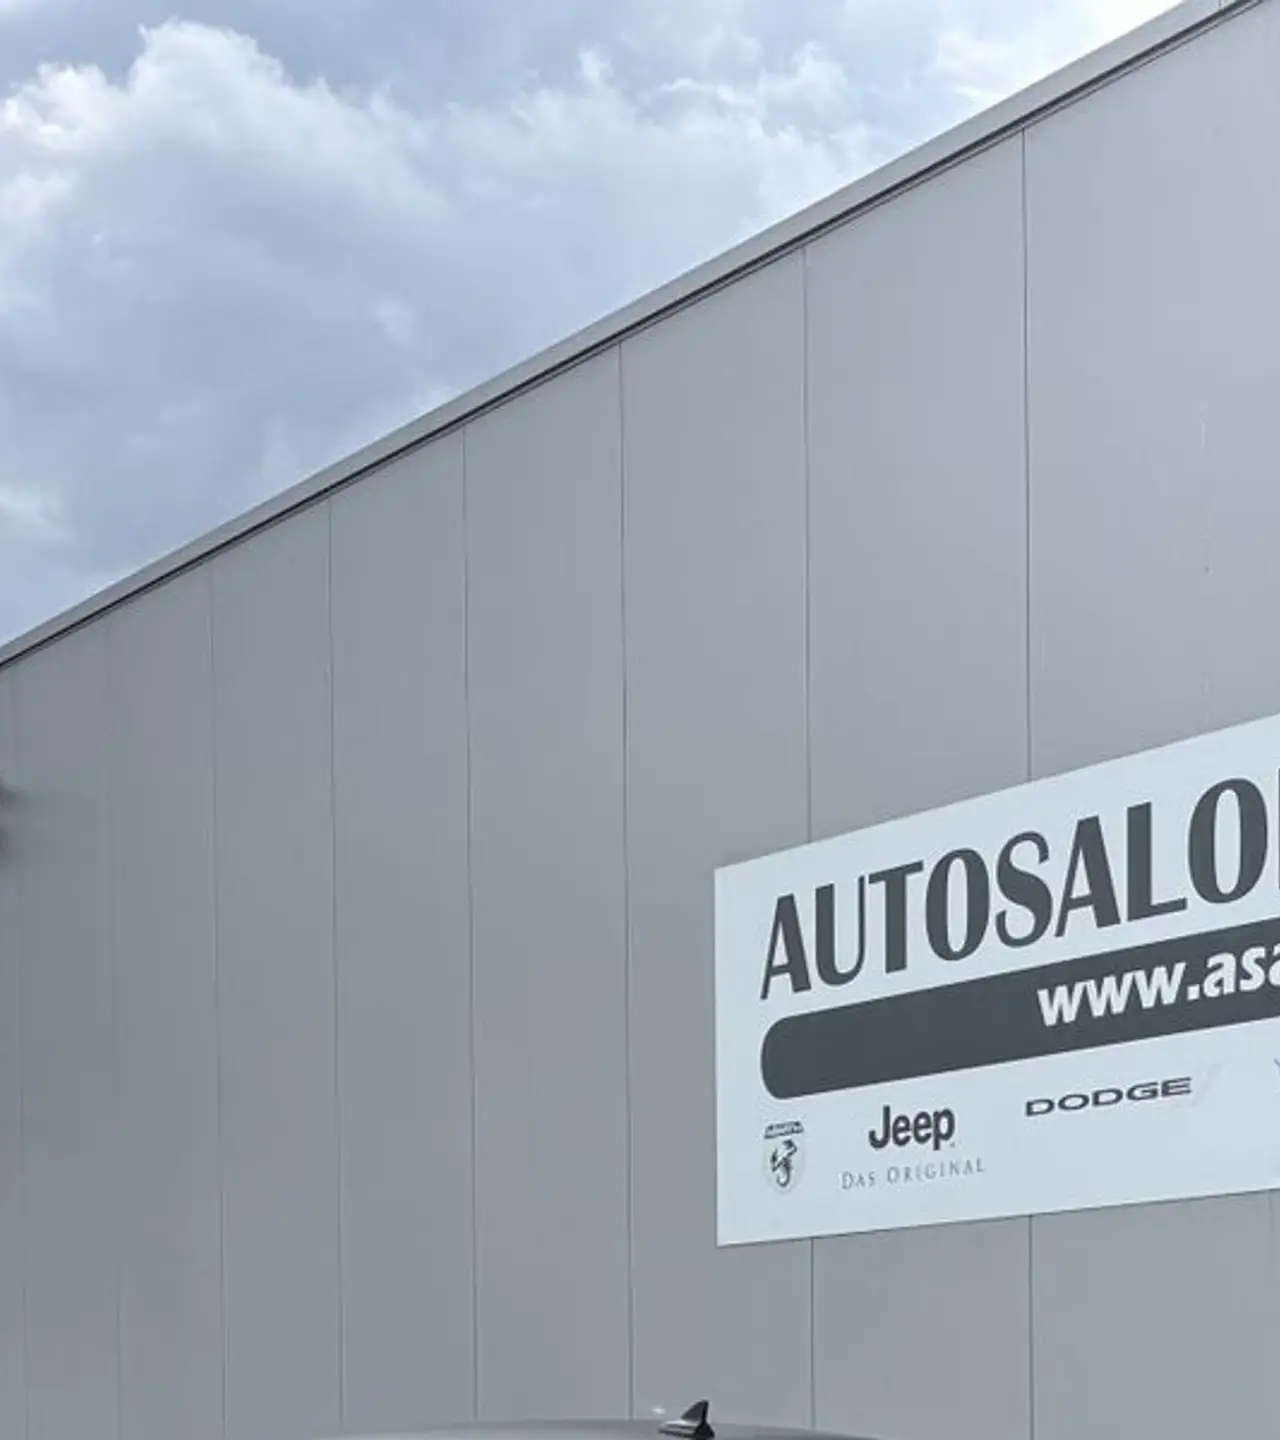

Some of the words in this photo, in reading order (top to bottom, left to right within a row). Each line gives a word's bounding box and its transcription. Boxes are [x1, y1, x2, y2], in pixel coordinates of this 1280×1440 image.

[1025, 1076, 1193, 1118] DODGE
[868, 1105, 956, 1151] Jeep
[840, 1170, 877, 1190] DAS
[886, 1156, 986, 1186] ORIGINAL
